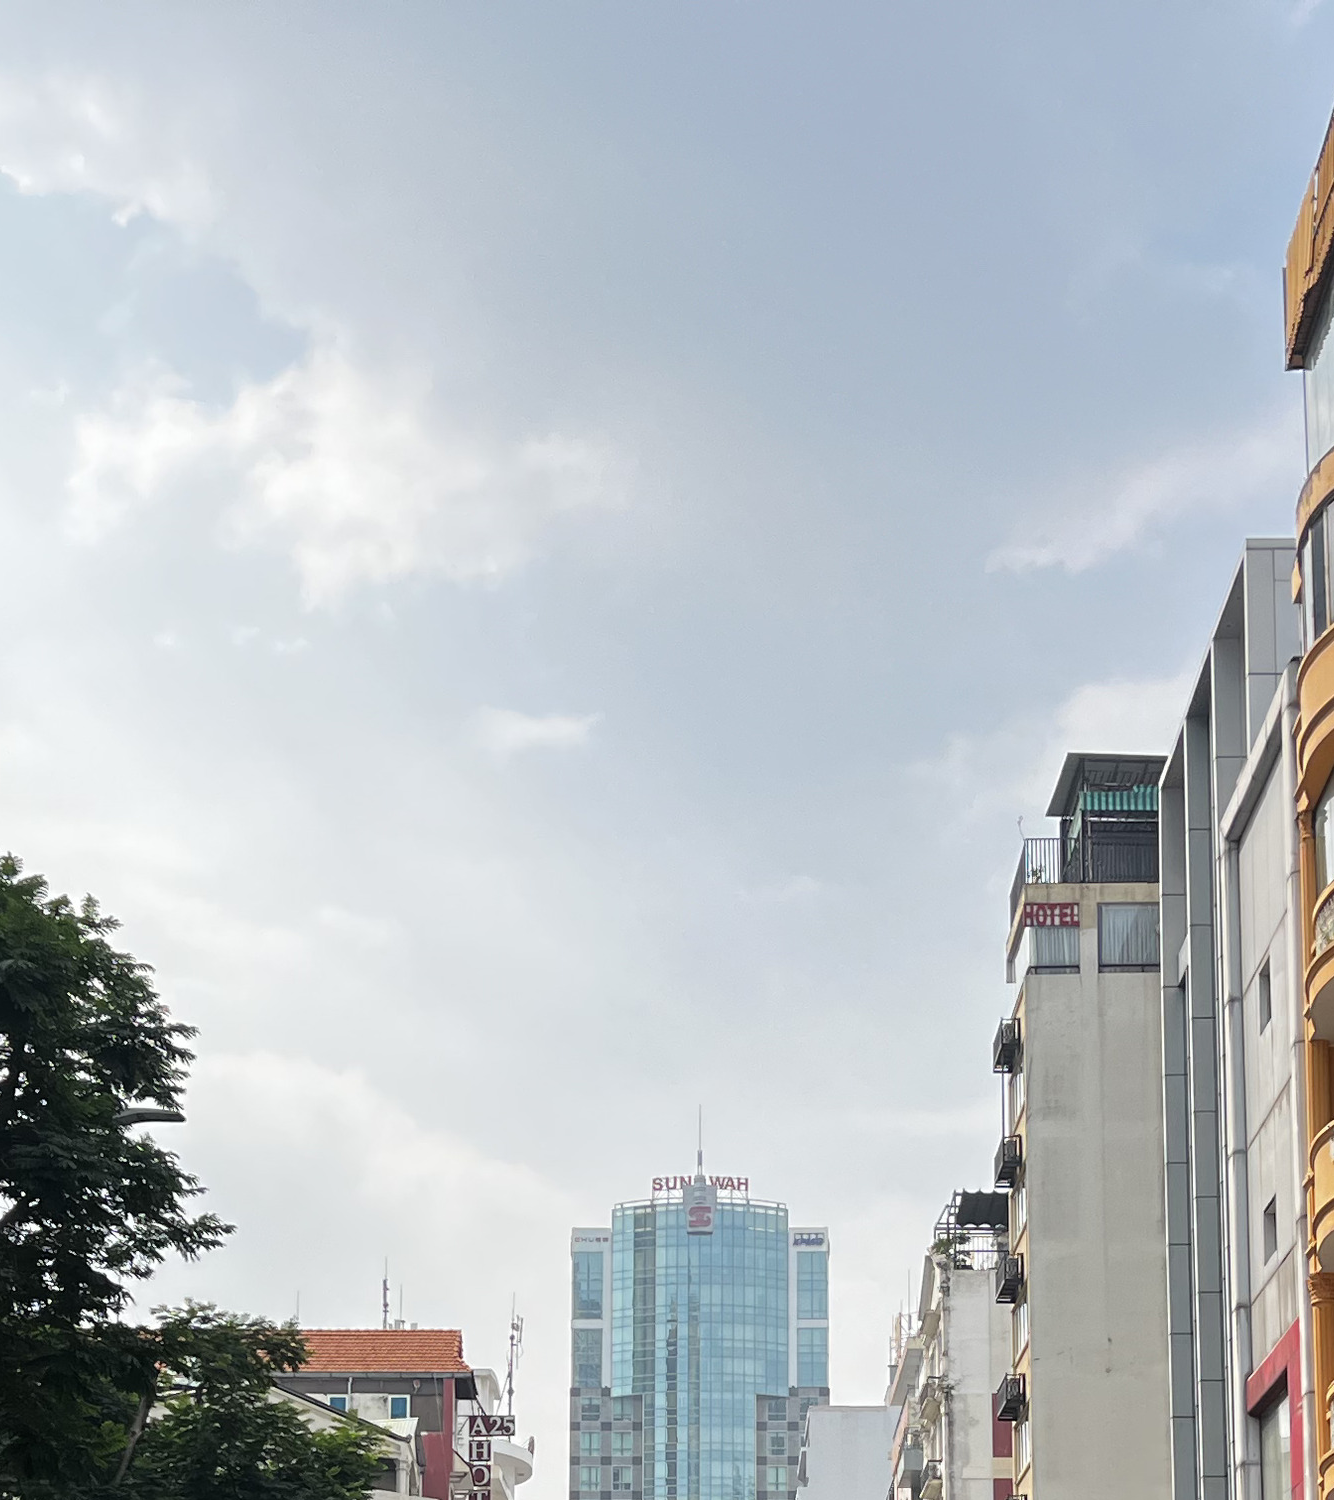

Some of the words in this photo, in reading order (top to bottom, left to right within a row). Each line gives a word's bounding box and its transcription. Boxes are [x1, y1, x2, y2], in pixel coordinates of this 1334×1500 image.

[1024, 903, 1080, 927] HOTEL
[652, 1176, 692, 1192] SUN
[709, 1176, 749, 1192] WAH
[470, 1416, 515, 1436] A25
